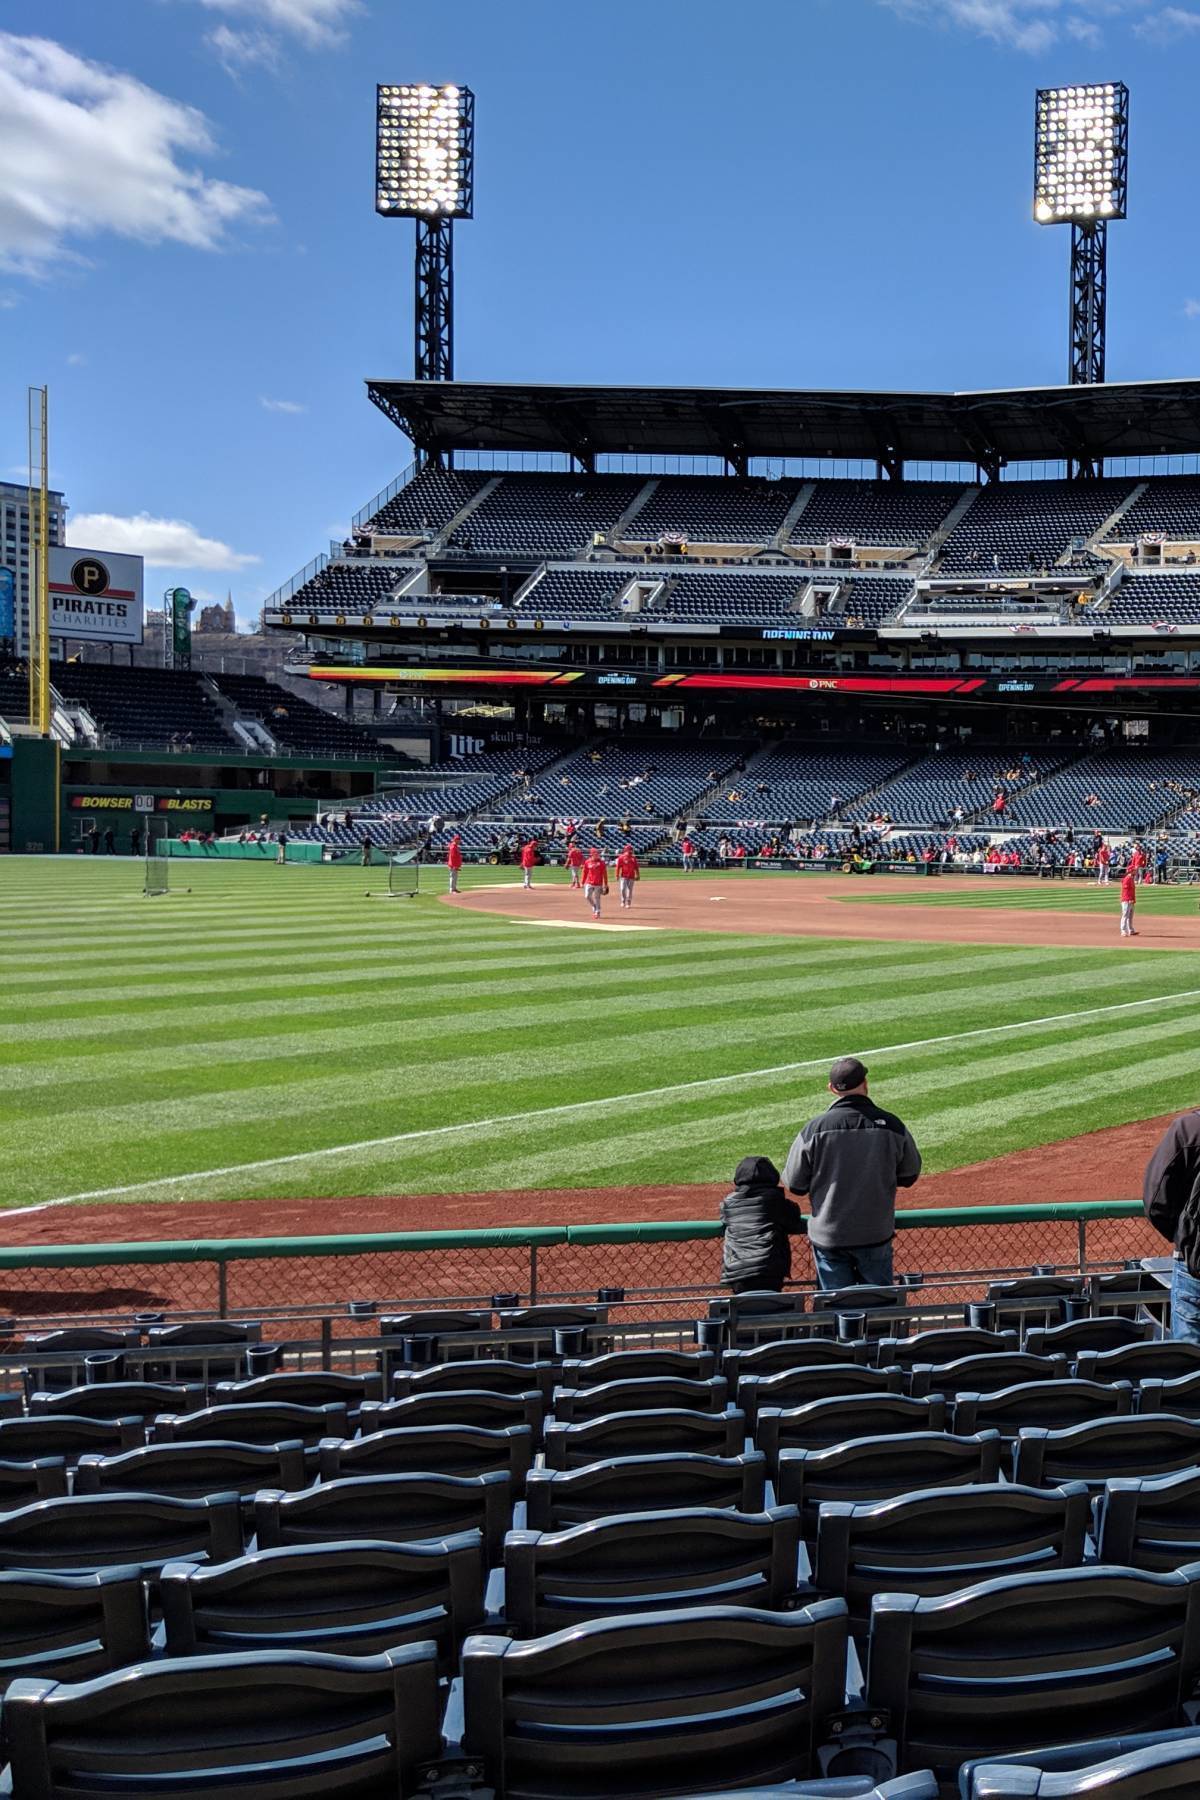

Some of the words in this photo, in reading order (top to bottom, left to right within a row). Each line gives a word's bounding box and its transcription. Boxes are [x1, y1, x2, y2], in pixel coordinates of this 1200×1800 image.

[52, 597, 128, 617] PIRATES
[52, 612, 128, 629] CHARITIES
[819, 681, 838, 689] PNC
[449, 734, 485, 760] lite
[82, 797, 133, 808] BOWSER
[168, 799, 212, 810] BLASTS
